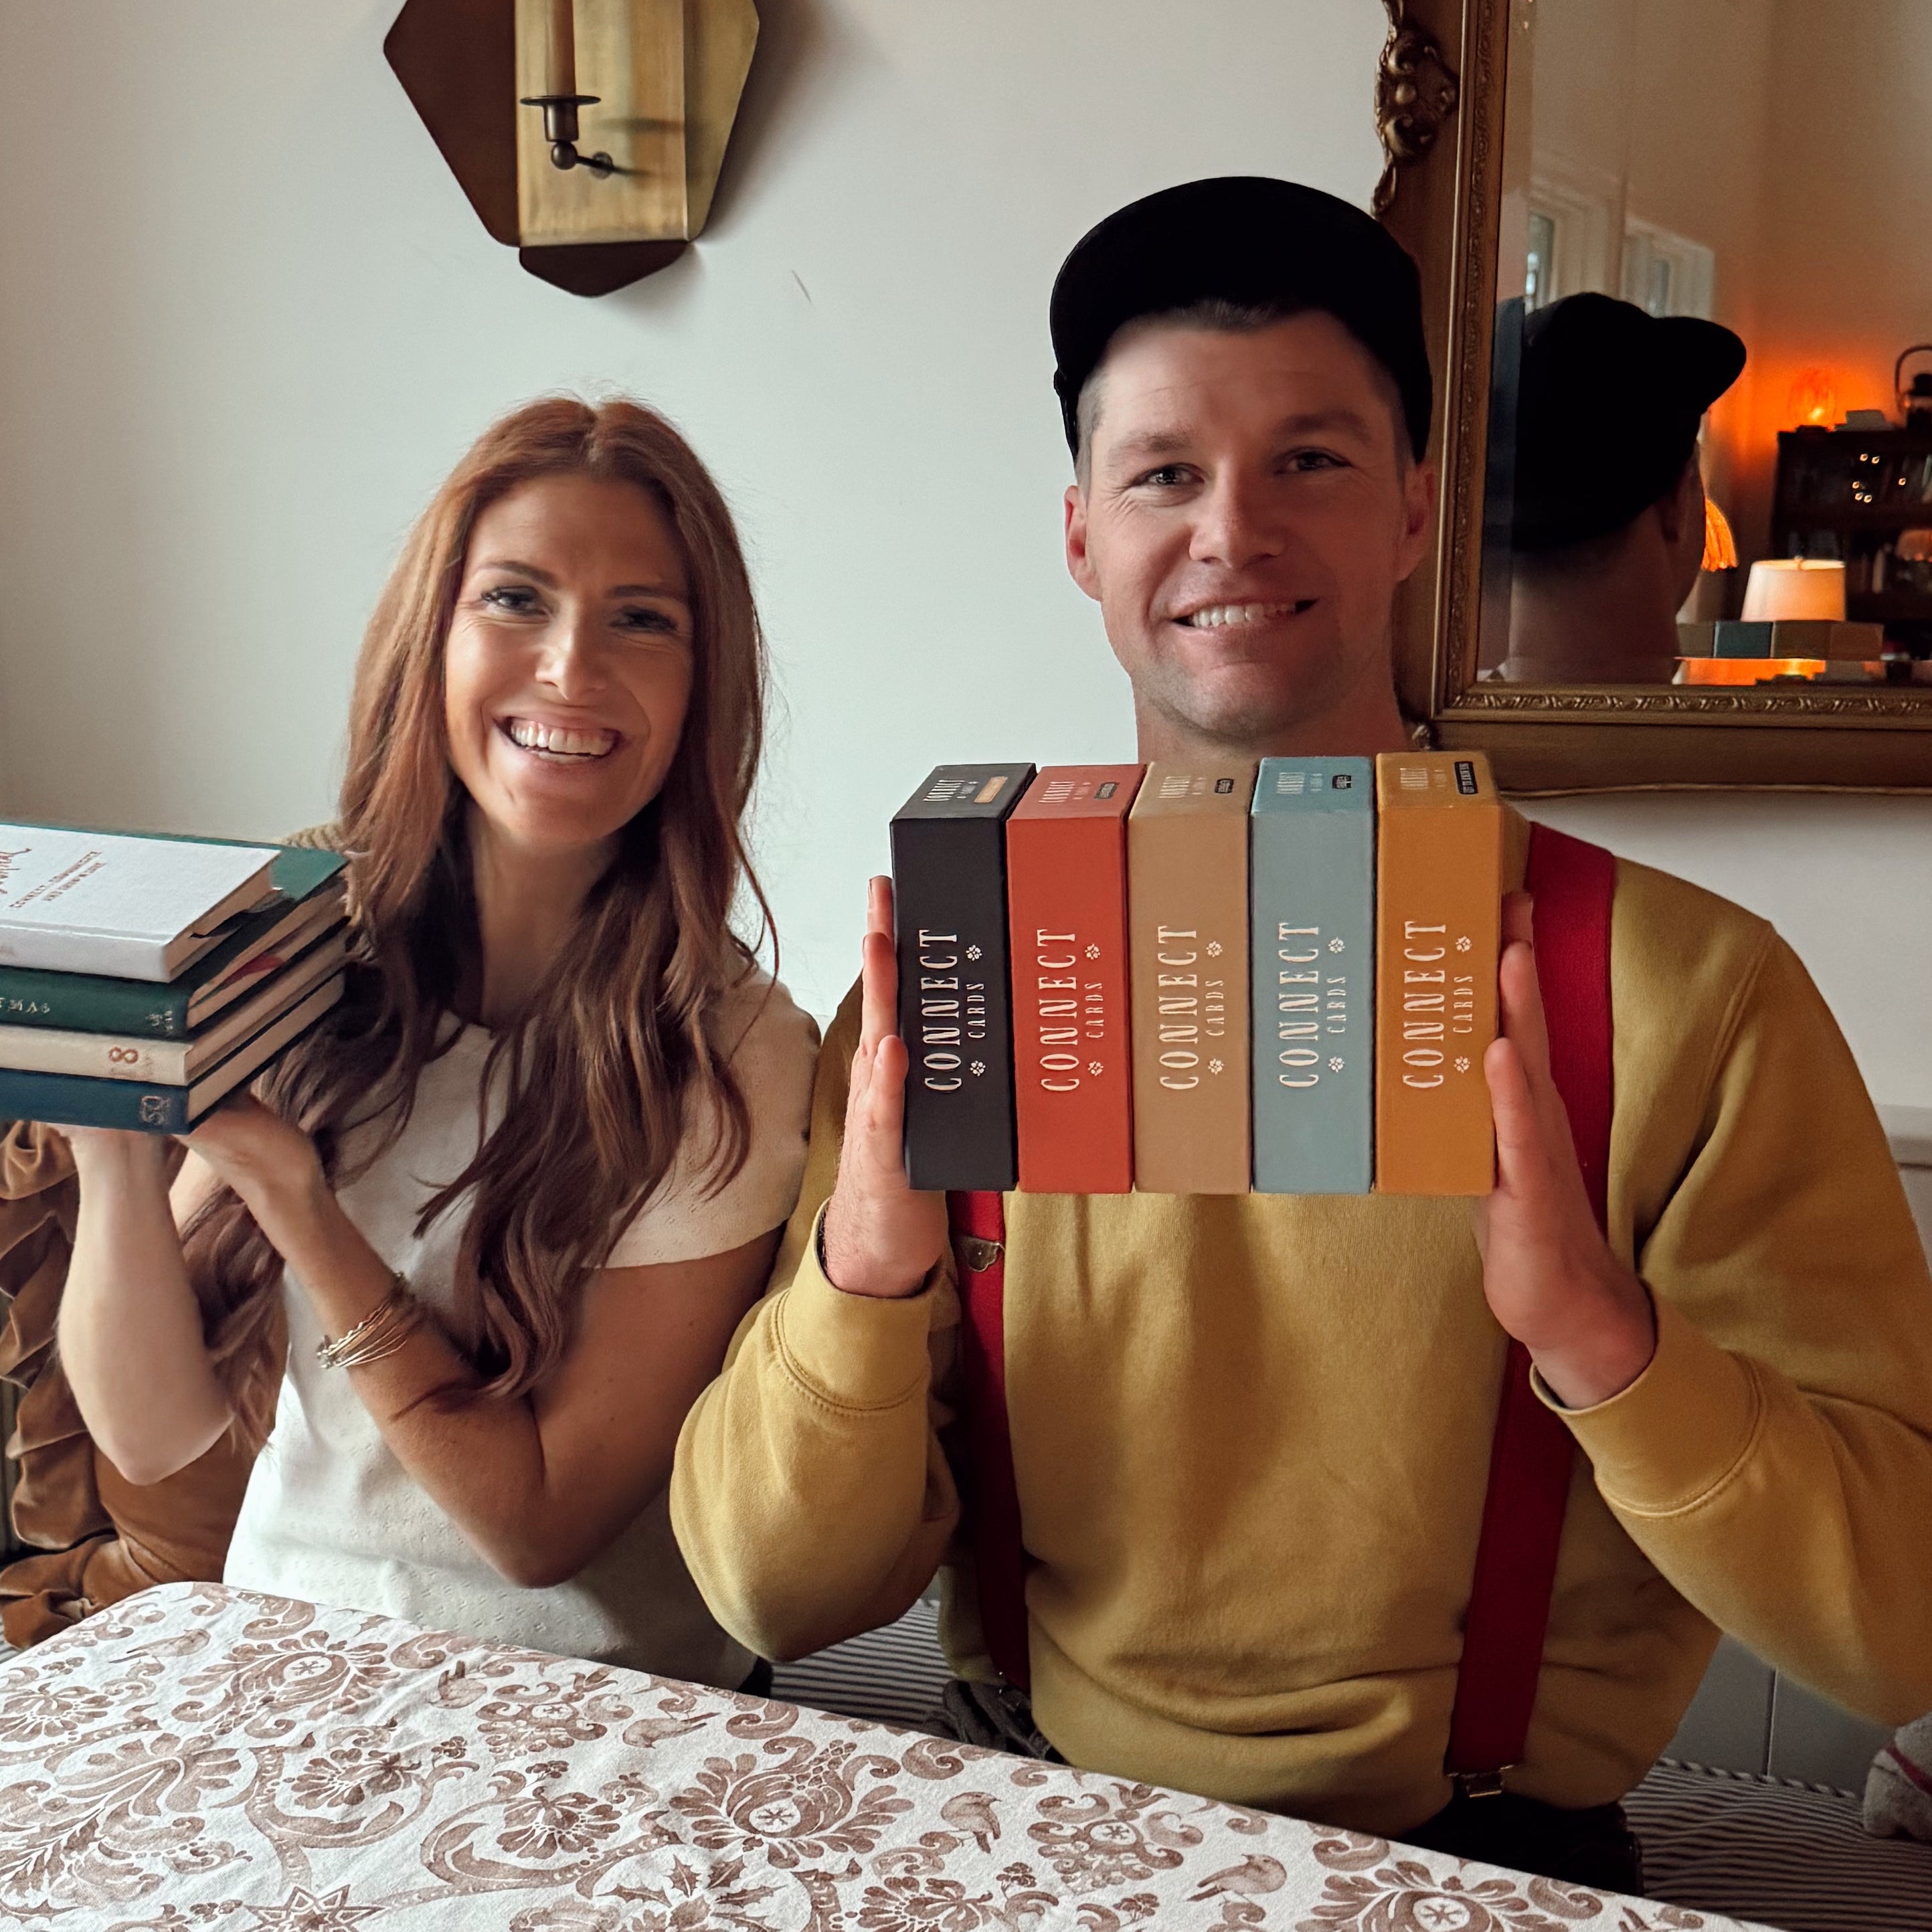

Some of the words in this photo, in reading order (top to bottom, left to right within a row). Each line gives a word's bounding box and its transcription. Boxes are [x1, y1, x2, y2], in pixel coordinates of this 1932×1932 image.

[919, 929, 962, 1091] CONNECT
[966, 983, 986, 1039] CARDS
[1037, 929, 1080, 1091] CONNECT
[1085, 982, 1104, 1039] CARDS
[1157, 925, 1199, 1090] CONNECT
[1205, 980, 1225, 1037] CARDS
[1278, 922, 1320, 1087] CONNECT
[1326, 976, 1346, 1033] CARDS
[1402, 921, 1446, 1089] CONNECT
[1452, 976, 1474, 1033] CARDS
